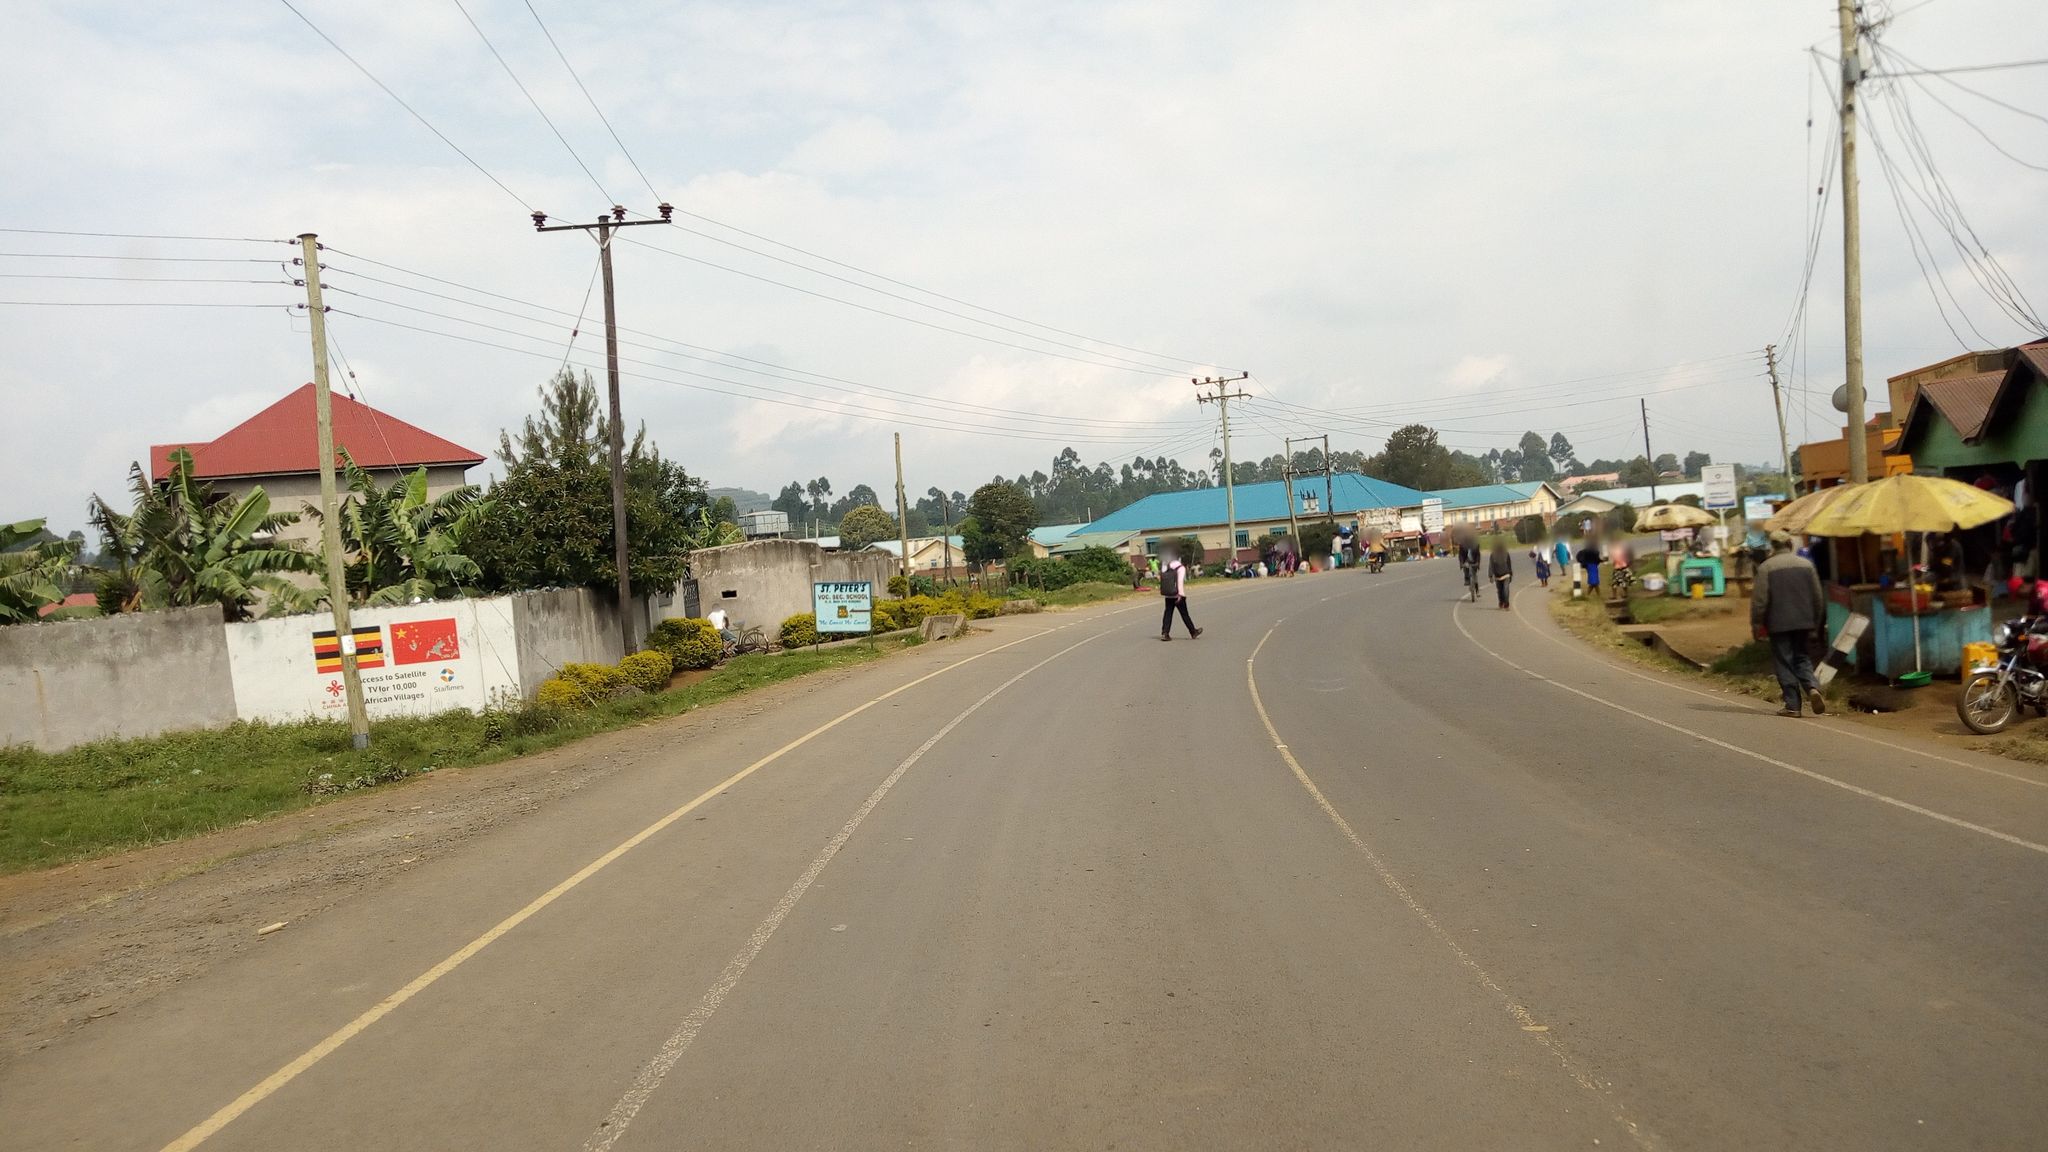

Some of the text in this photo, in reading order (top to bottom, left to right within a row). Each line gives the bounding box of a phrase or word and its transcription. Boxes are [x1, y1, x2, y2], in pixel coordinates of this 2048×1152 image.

[821, 583, 866, 593] ST. PETER'S
[394, 671, 427, 680] Satellite
[368, 685, 378, 693] TV
[392, 682, 417, 691] 10,000
[364, 692, 425, 705] African Villages
